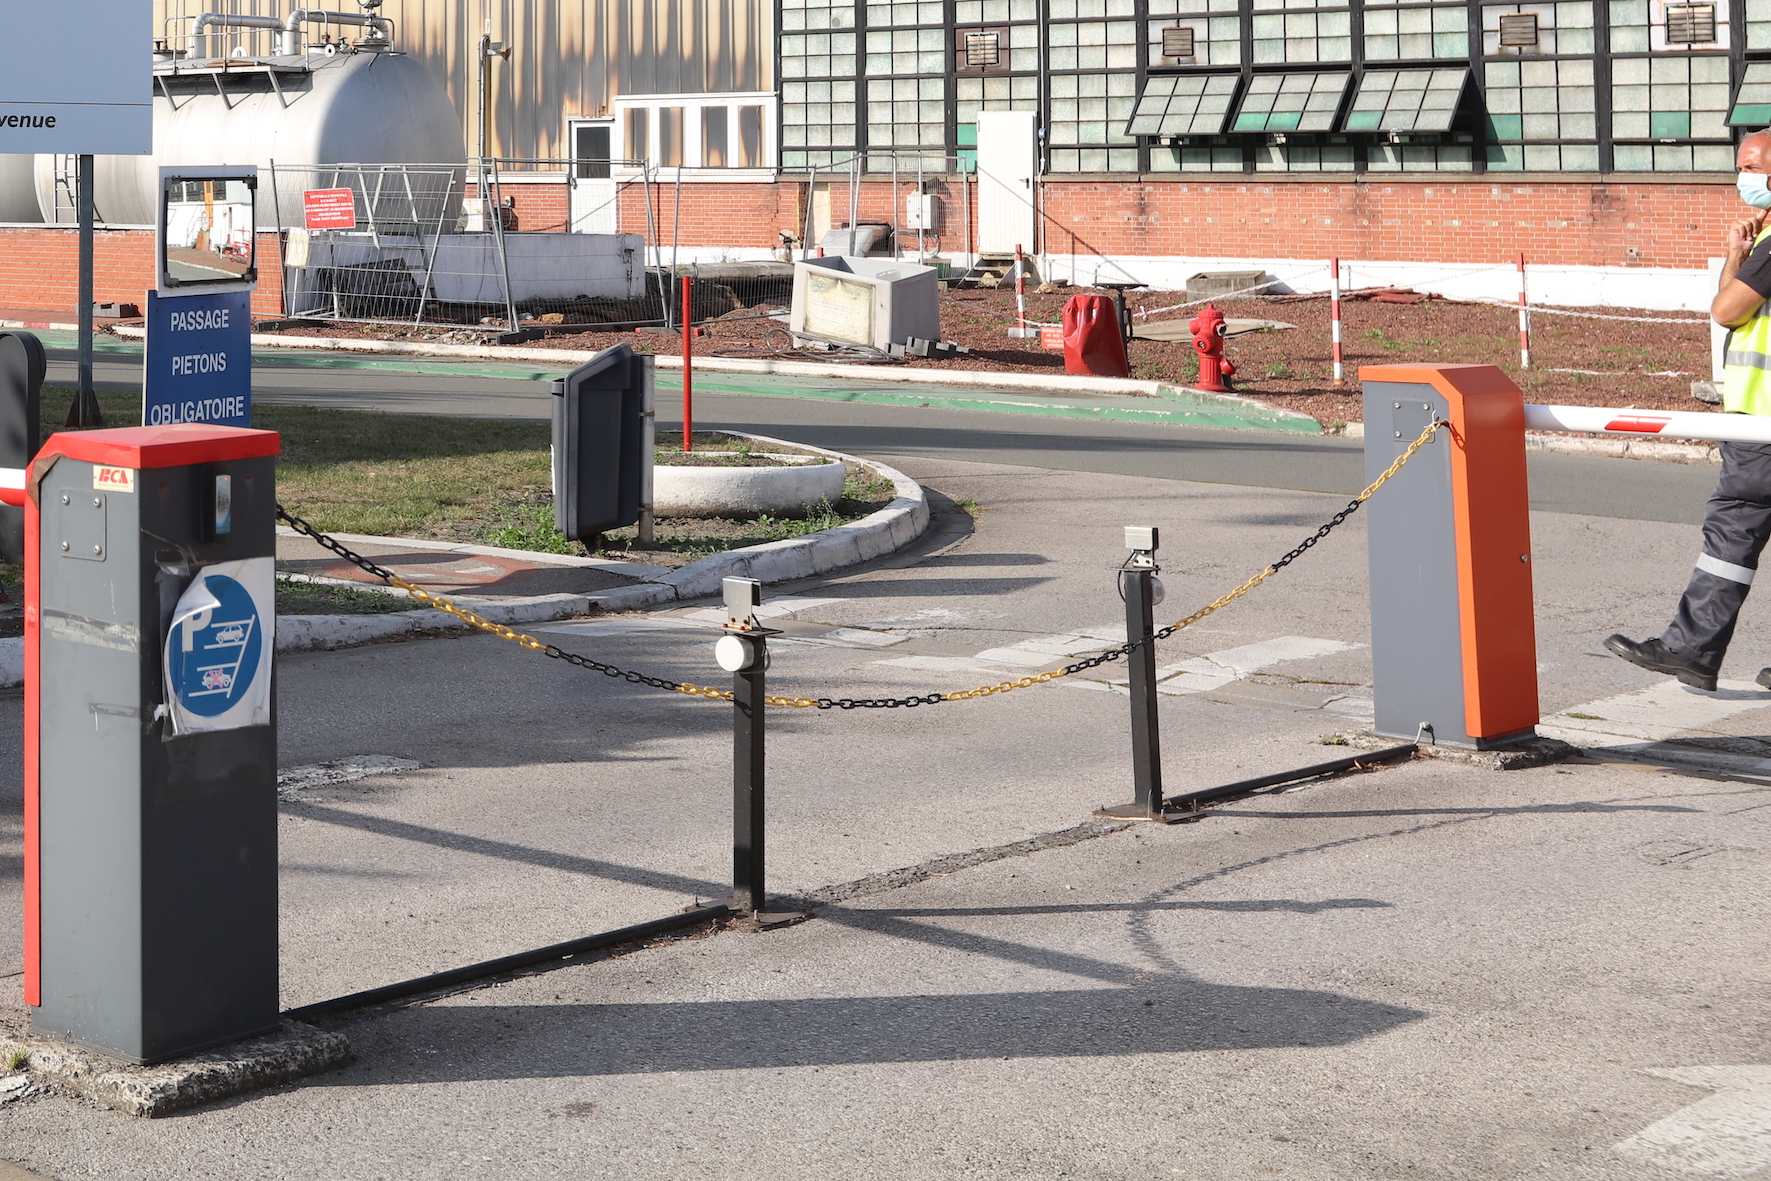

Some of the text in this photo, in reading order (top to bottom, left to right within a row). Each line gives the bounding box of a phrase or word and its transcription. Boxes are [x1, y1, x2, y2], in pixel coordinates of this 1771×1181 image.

[170, 308, 230, 332] PASSAGE
[171, 351, 227, 376] PIETONS
[150, 395, 245, 426] OBLIGATOIRE
[98, 468, 129, 484] BCA
